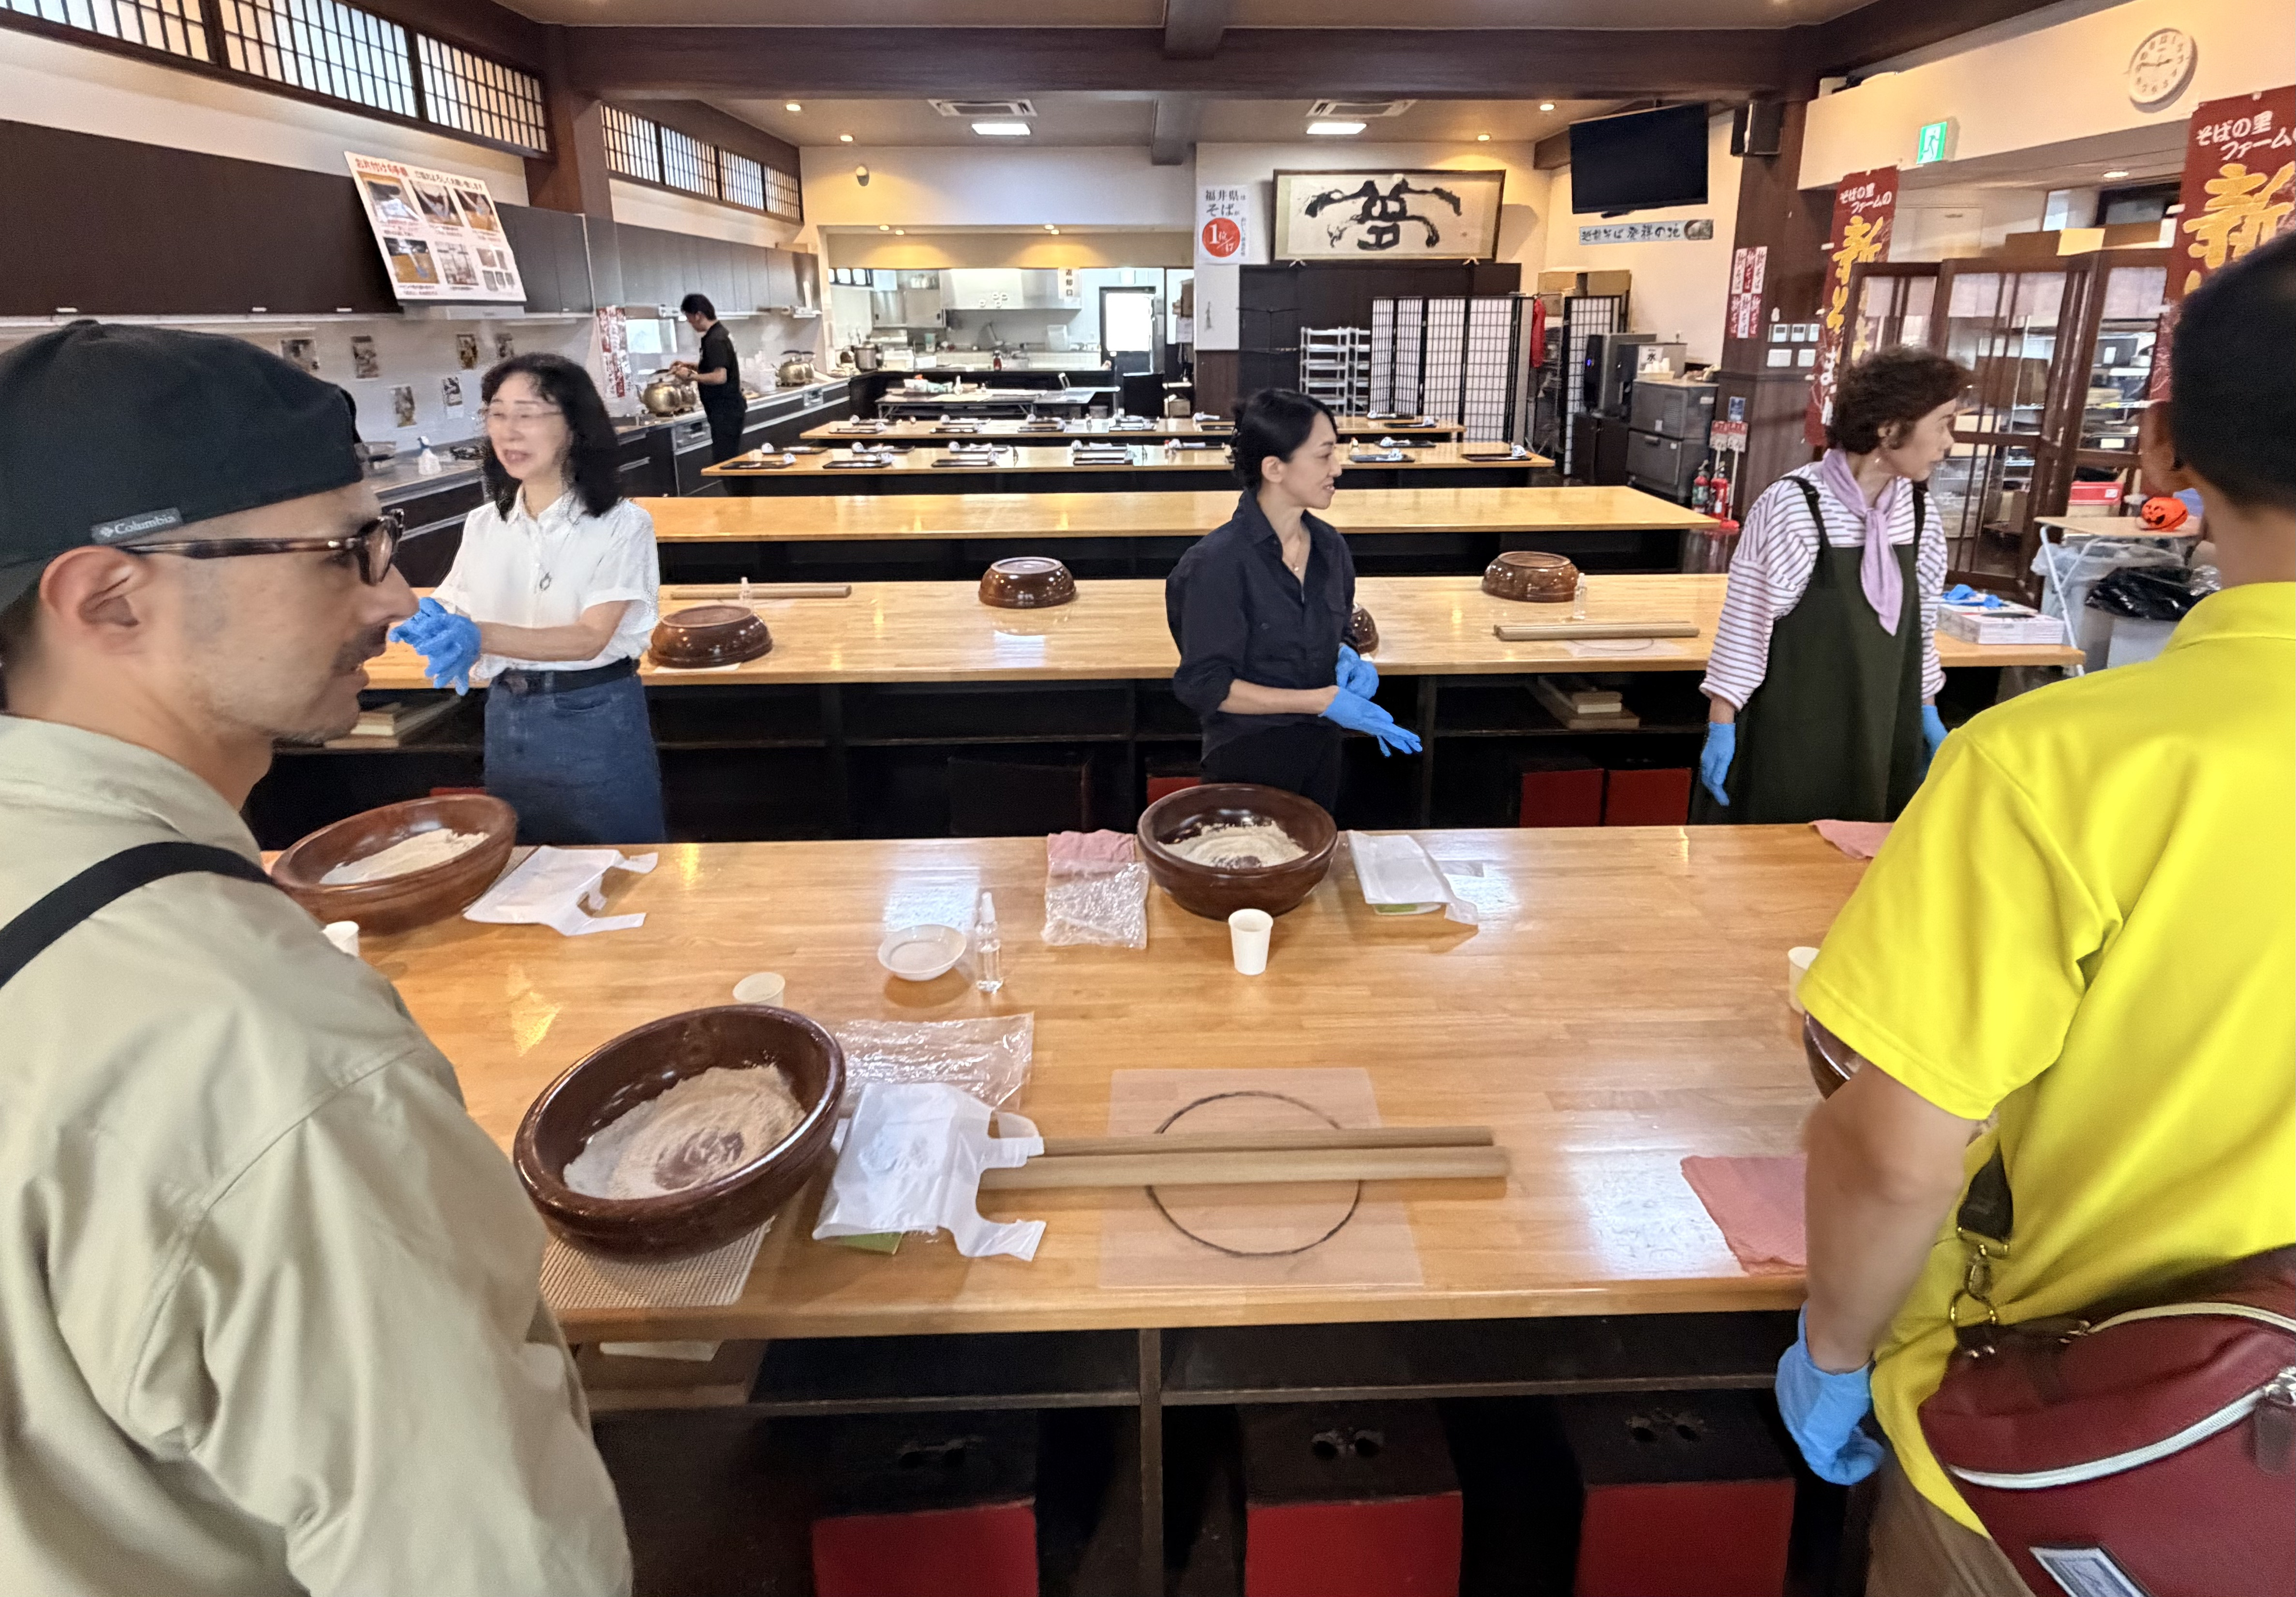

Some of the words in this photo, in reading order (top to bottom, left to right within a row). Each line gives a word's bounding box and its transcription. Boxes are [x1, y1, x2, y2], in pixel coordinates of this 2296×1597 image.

[2196, 110, 2273, 146] そばの里
[2220, 127, 2296, 161] ファーム
[1839, 182, 1875, 204] そばの里
[1851, 191, 1892, 214] ファームの
[115, 515, 176, 534] Columbia
